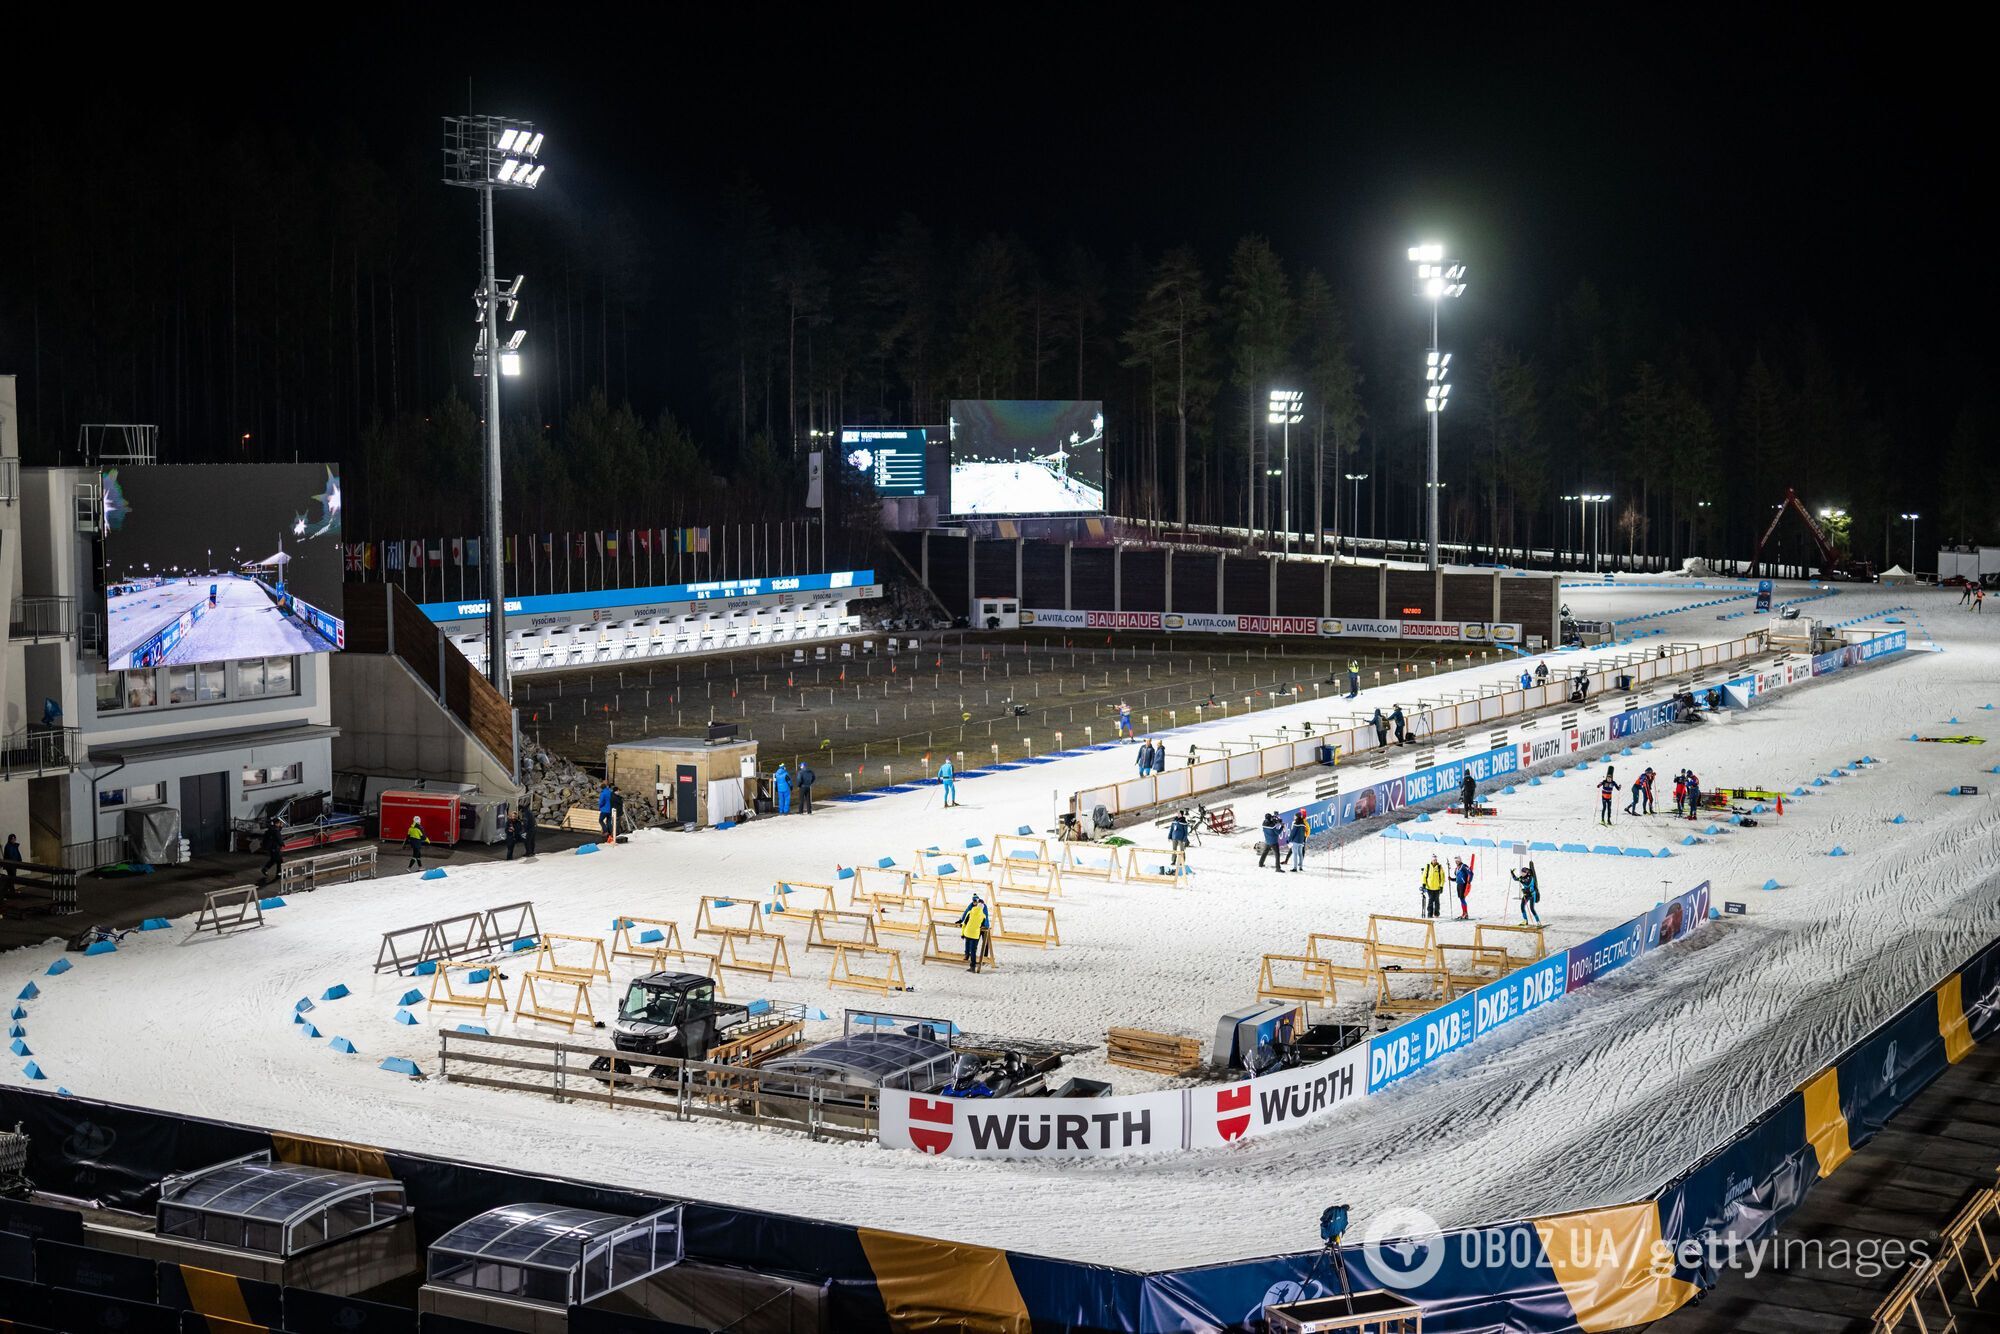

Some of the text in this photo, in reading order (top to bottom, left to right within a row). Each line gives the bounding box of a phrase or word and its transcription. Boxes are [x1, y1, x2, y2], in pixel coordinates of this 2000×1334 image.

[532, 615, 556, 627] Vysočina
[634, 606, 656, 618] Vysočina
[1038, 614, 1082, 623] LAVITA.COM
[1088, 614, 1160, 626] BAUHAUS
[1188, 618, 1236, 628] LAVITA.COM
[1240, 618, 1316, 632] BAUHAUS
[1346, 623, 1398, 633] LAVITA.COM
[1403, 624, 1459, 636] BAUHAUS
[1764, 674, 1782, 690] WÜRTH
[1793, 664, 1810, 681] WÜRTH
[1630, 709, 1650, 733] 100%
[1580, 726, 1605, 748] WÜRTH
[1532, 738, 1560, 761] WÜRTH
[1492, 751, 1510, 776] DKB
[1408, 776, 1428, 802] DKB
[1436, 768, 1454, 793] DKB
[1382, 781, 1403, 814] iX2
[1571, 936, 1630, 982] 100% ELECTRIC
[1522, 968, 1554, 1010] DKB
[1478, 988, 1509, 1033] DKB
[1425, 1012, 1460, 1060] DKB
[1371, 1036, 1410, 1086] DKB
[1260, 1063, 1354, 1126] WÜRTH
[968, 1110, 1150, 1150] WÜRTH
